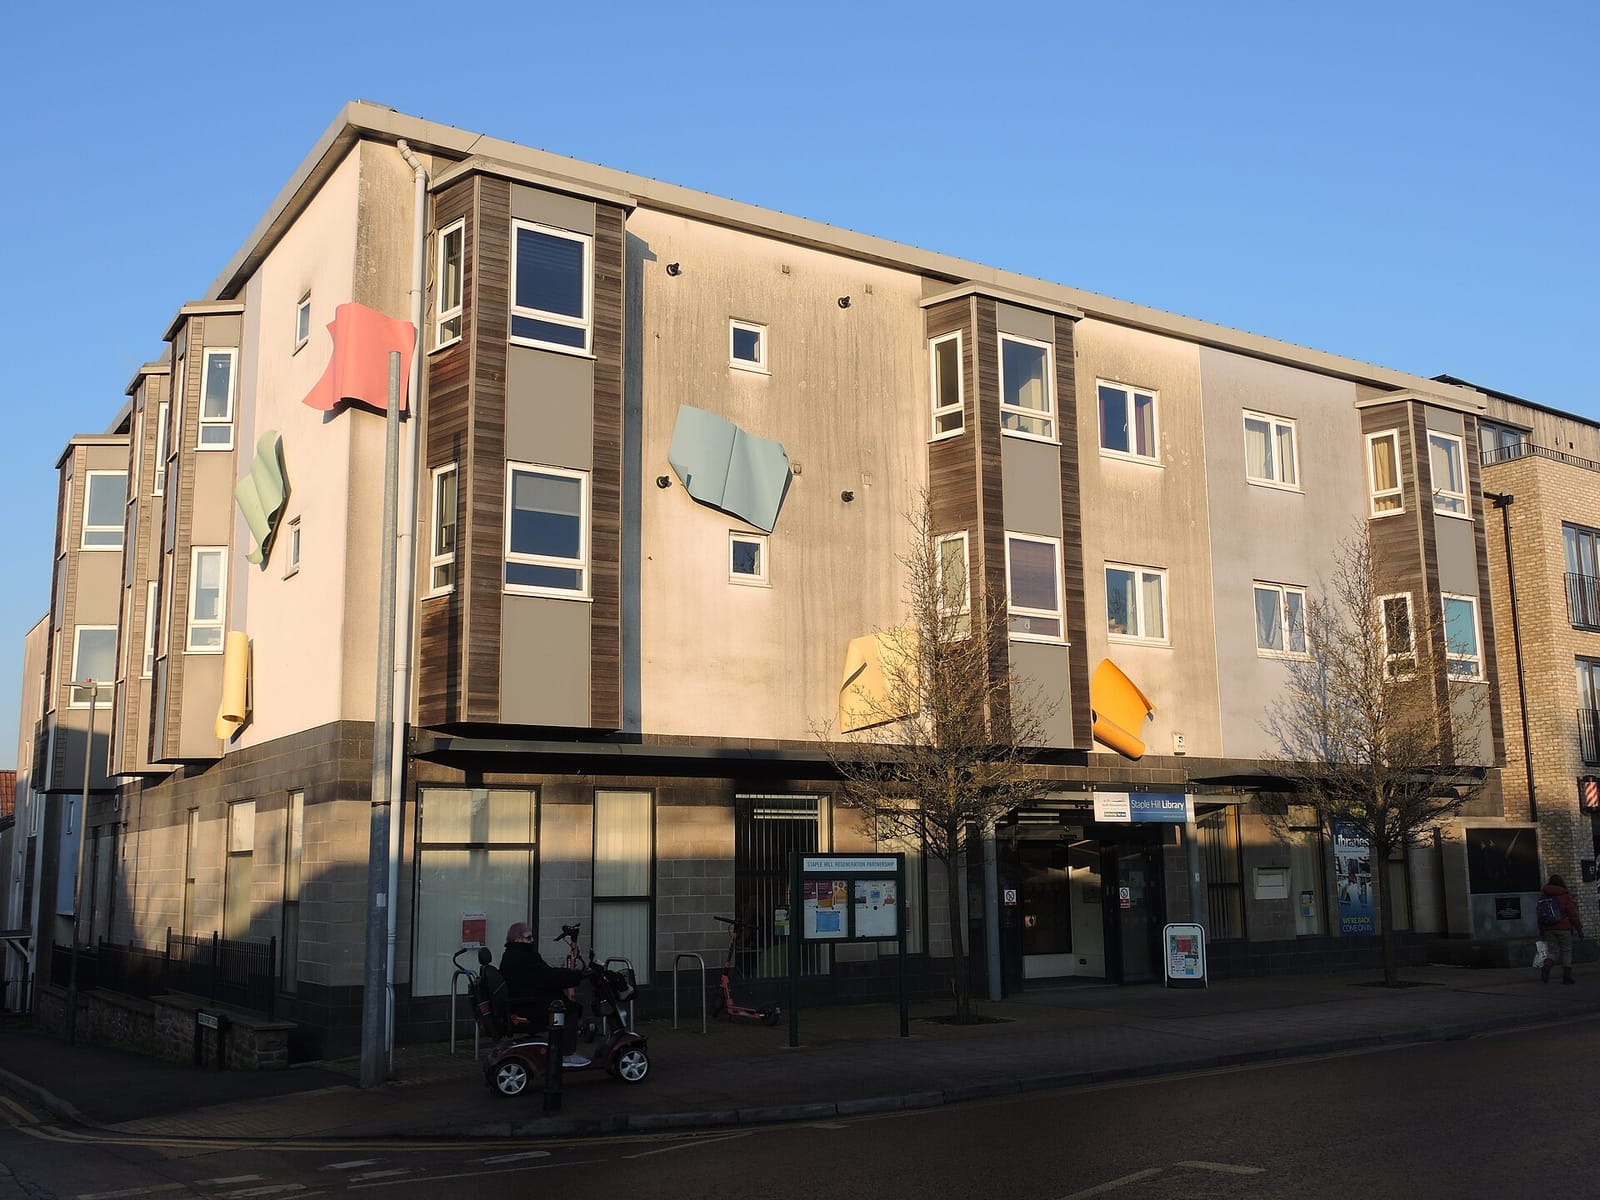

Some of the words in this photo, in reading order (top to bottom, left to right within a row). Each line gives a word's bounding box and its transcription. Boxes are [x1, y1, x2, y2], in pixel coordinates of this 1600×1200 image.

[1131, 800, 1150, 810] Staple
[1151, 800, 1161, 809] Hill
[1162, 800, 1185, 811] Library
[1333, 834, 1370, 848] Libraries
